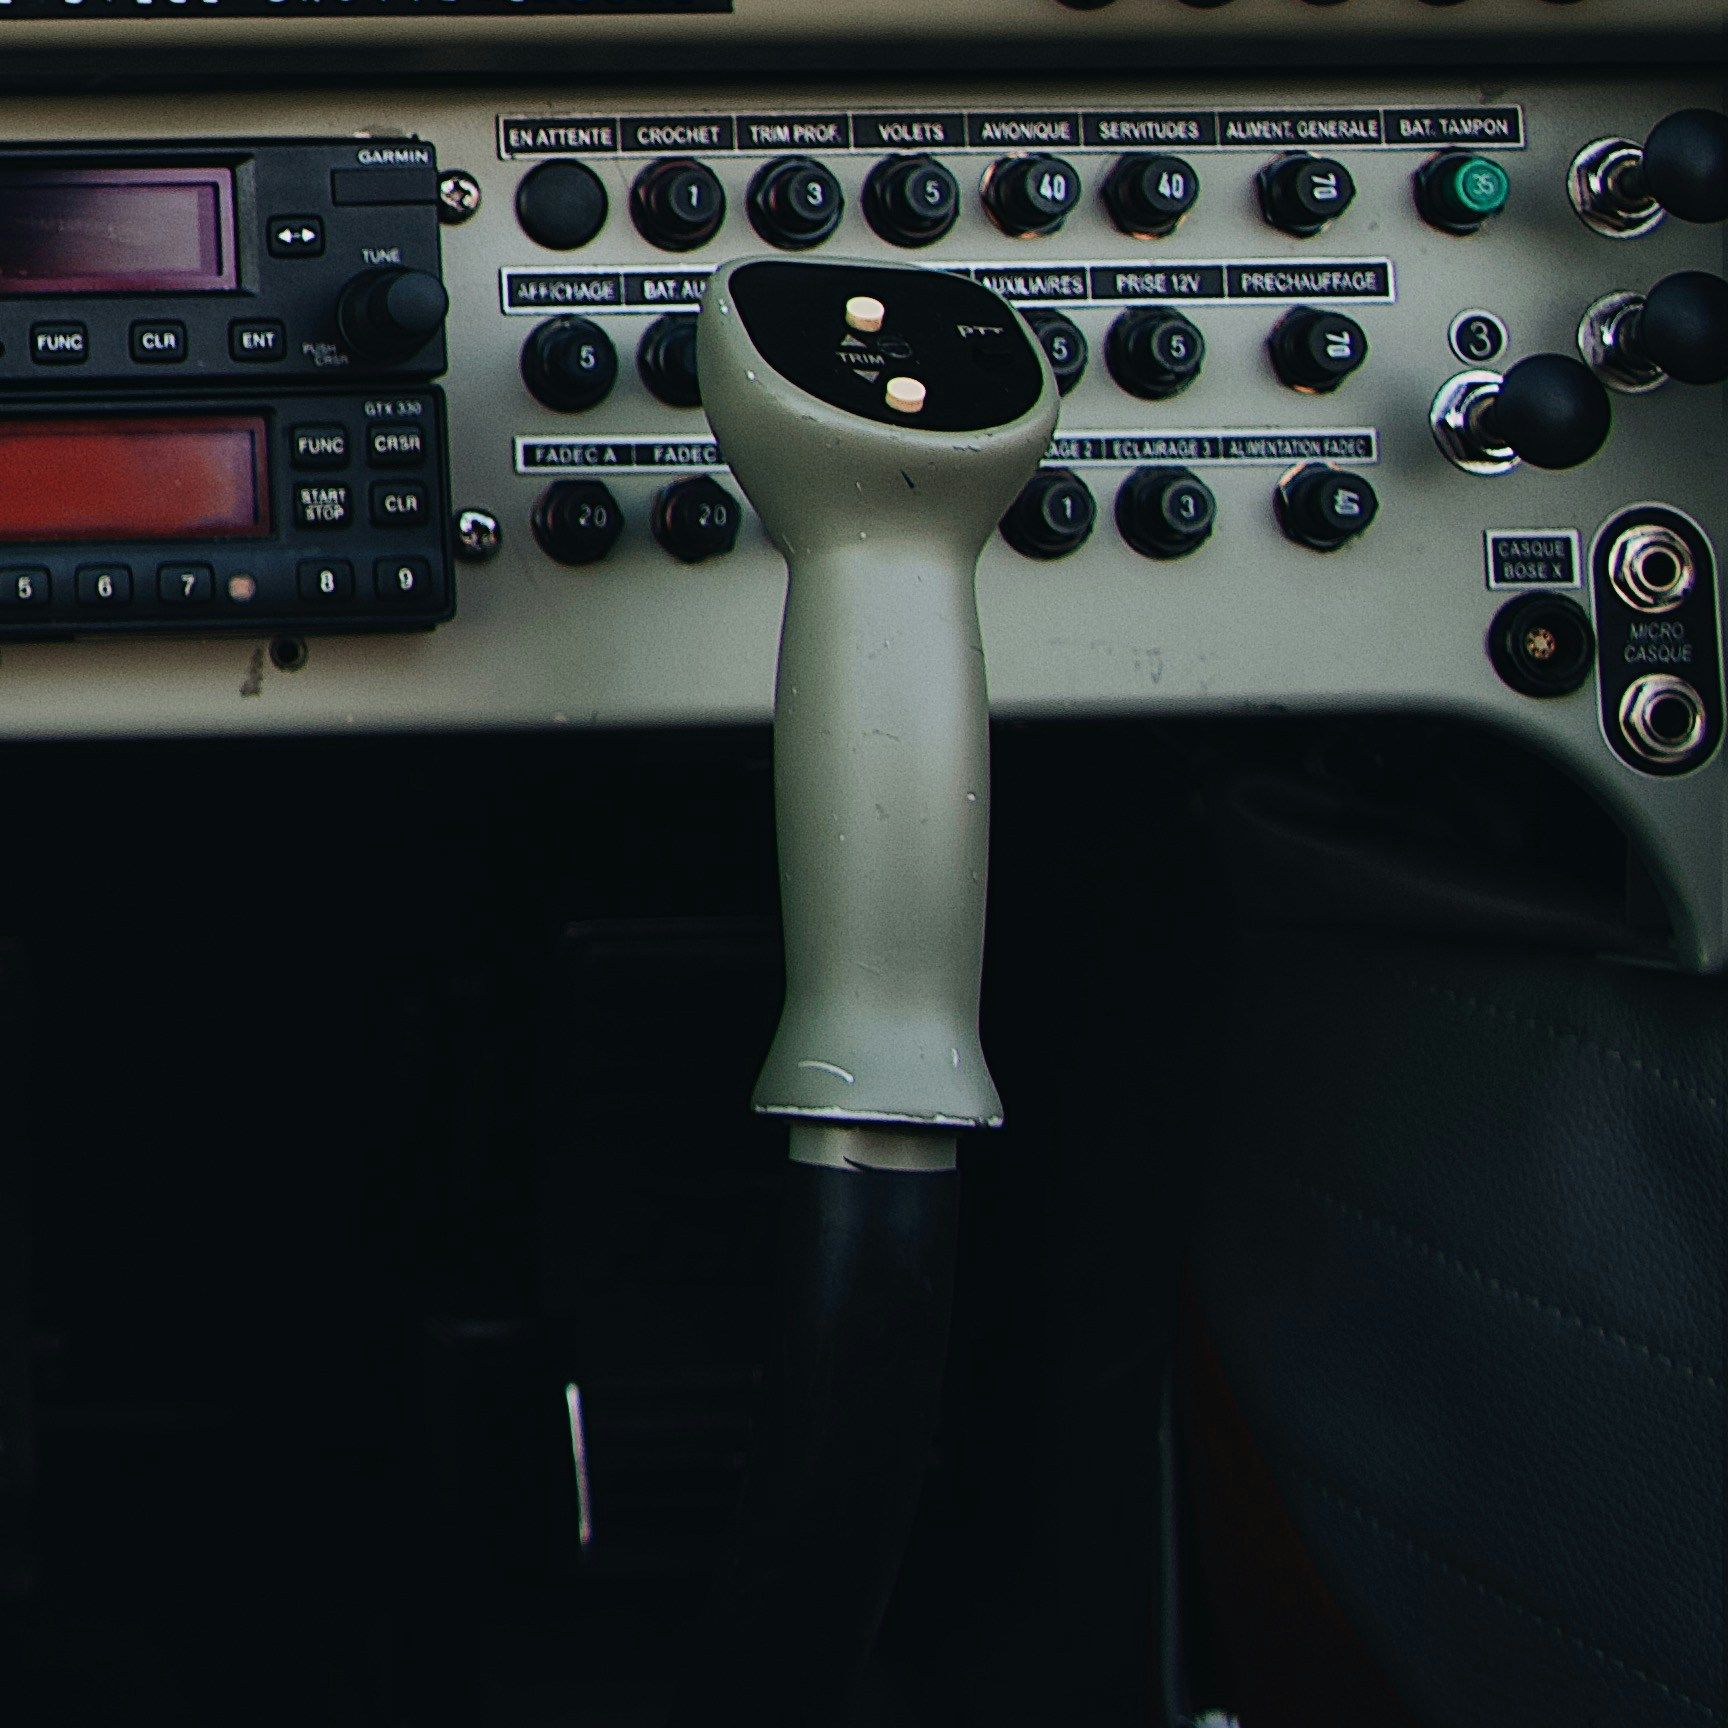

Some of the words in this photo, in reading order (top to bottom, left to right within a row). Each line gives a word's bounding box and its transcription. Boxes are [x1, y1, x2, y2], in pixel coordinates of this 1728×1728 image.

[638, 126, 720, 144] CROCHET
[879, 125, 944, 140] VOLETS
[1099, 122, 1199, 138] SERVITUDES
[1400, 120, 1436, 137] BAT.
[1440, 119, 1508, 136] TAMPON
[511, 130, 534, 146] EN
[536, 128, 611, 145] ATTENTE
[358, 150, 428, 163] GARMIN
[1242, 272, 1376, 291] PRECHAUFFAGE
[37, 335, 83, 351] FUNC
[243, 333, 275, 347] ENT
